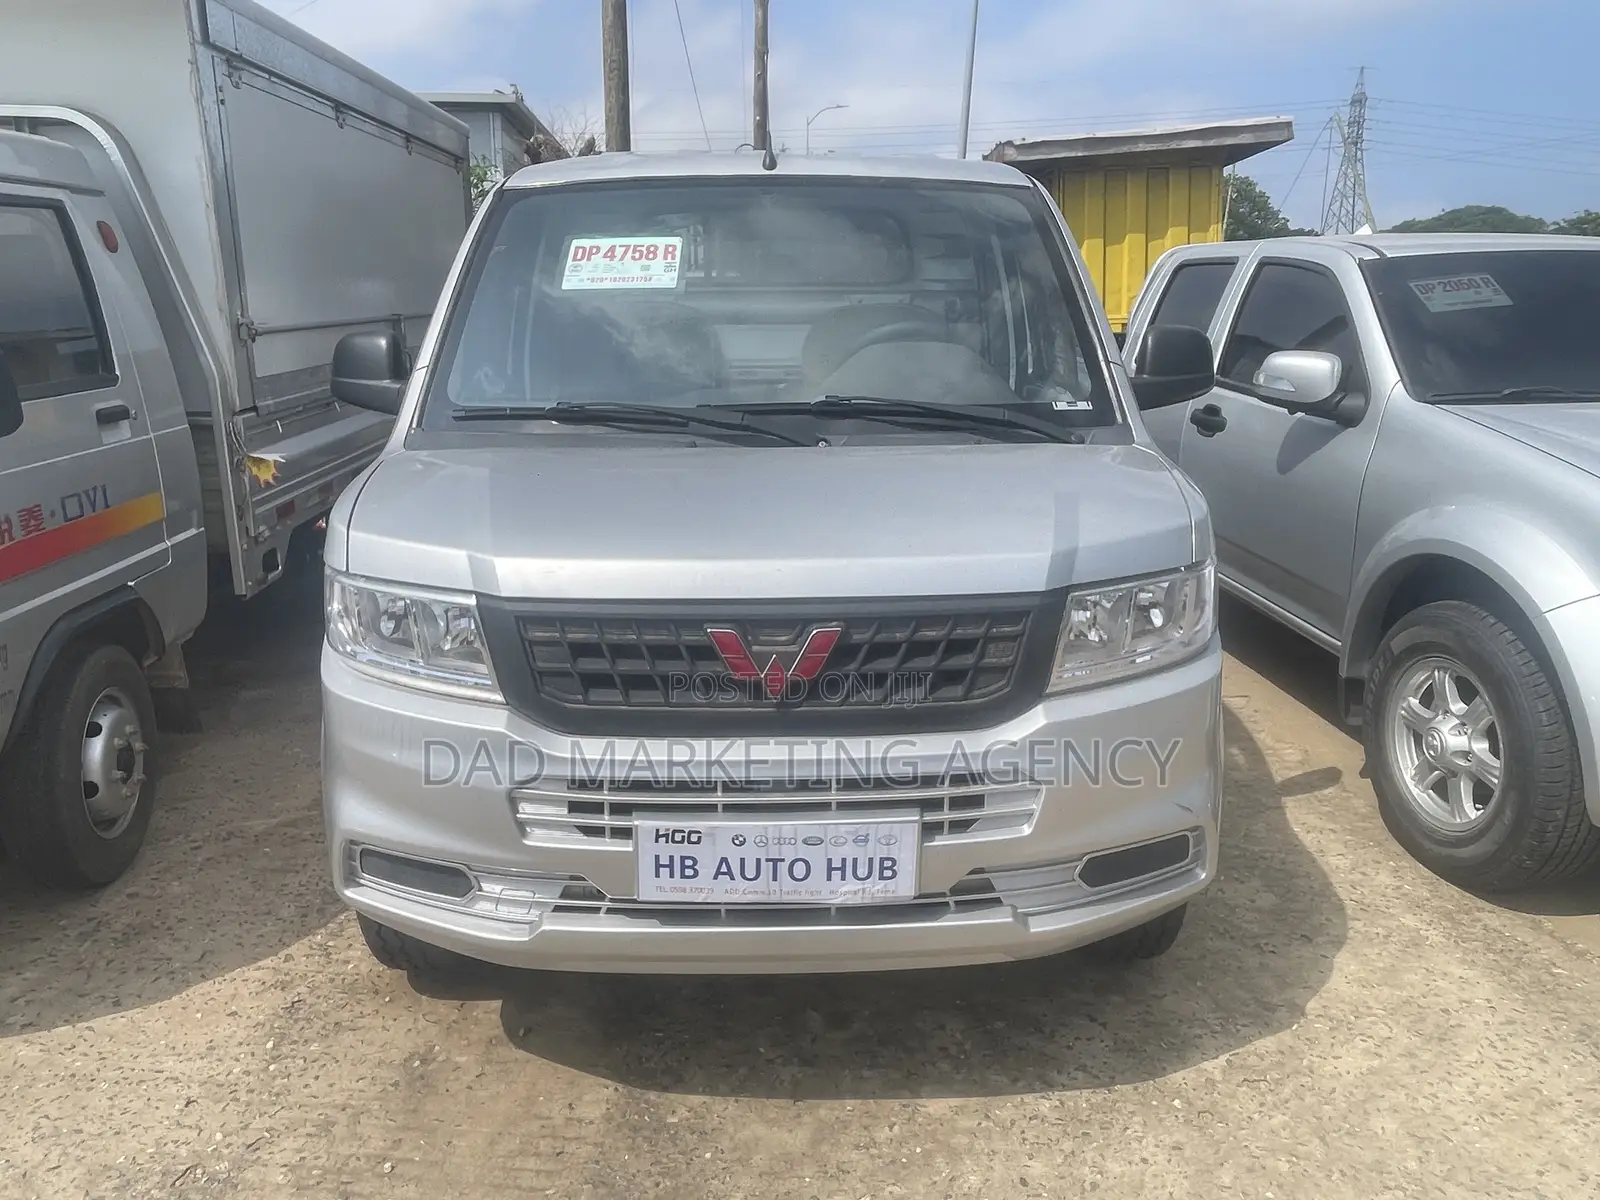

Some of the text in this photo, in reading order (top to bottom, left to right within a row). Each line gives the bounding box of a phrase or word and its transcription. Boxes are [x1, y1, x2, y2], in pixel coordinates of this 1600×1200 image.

[572, 244, 678, 262] DP 4758 R
[1413, 282, 1437, 295] DP
[654, 854, 898, 882] HB AUTO HUB
